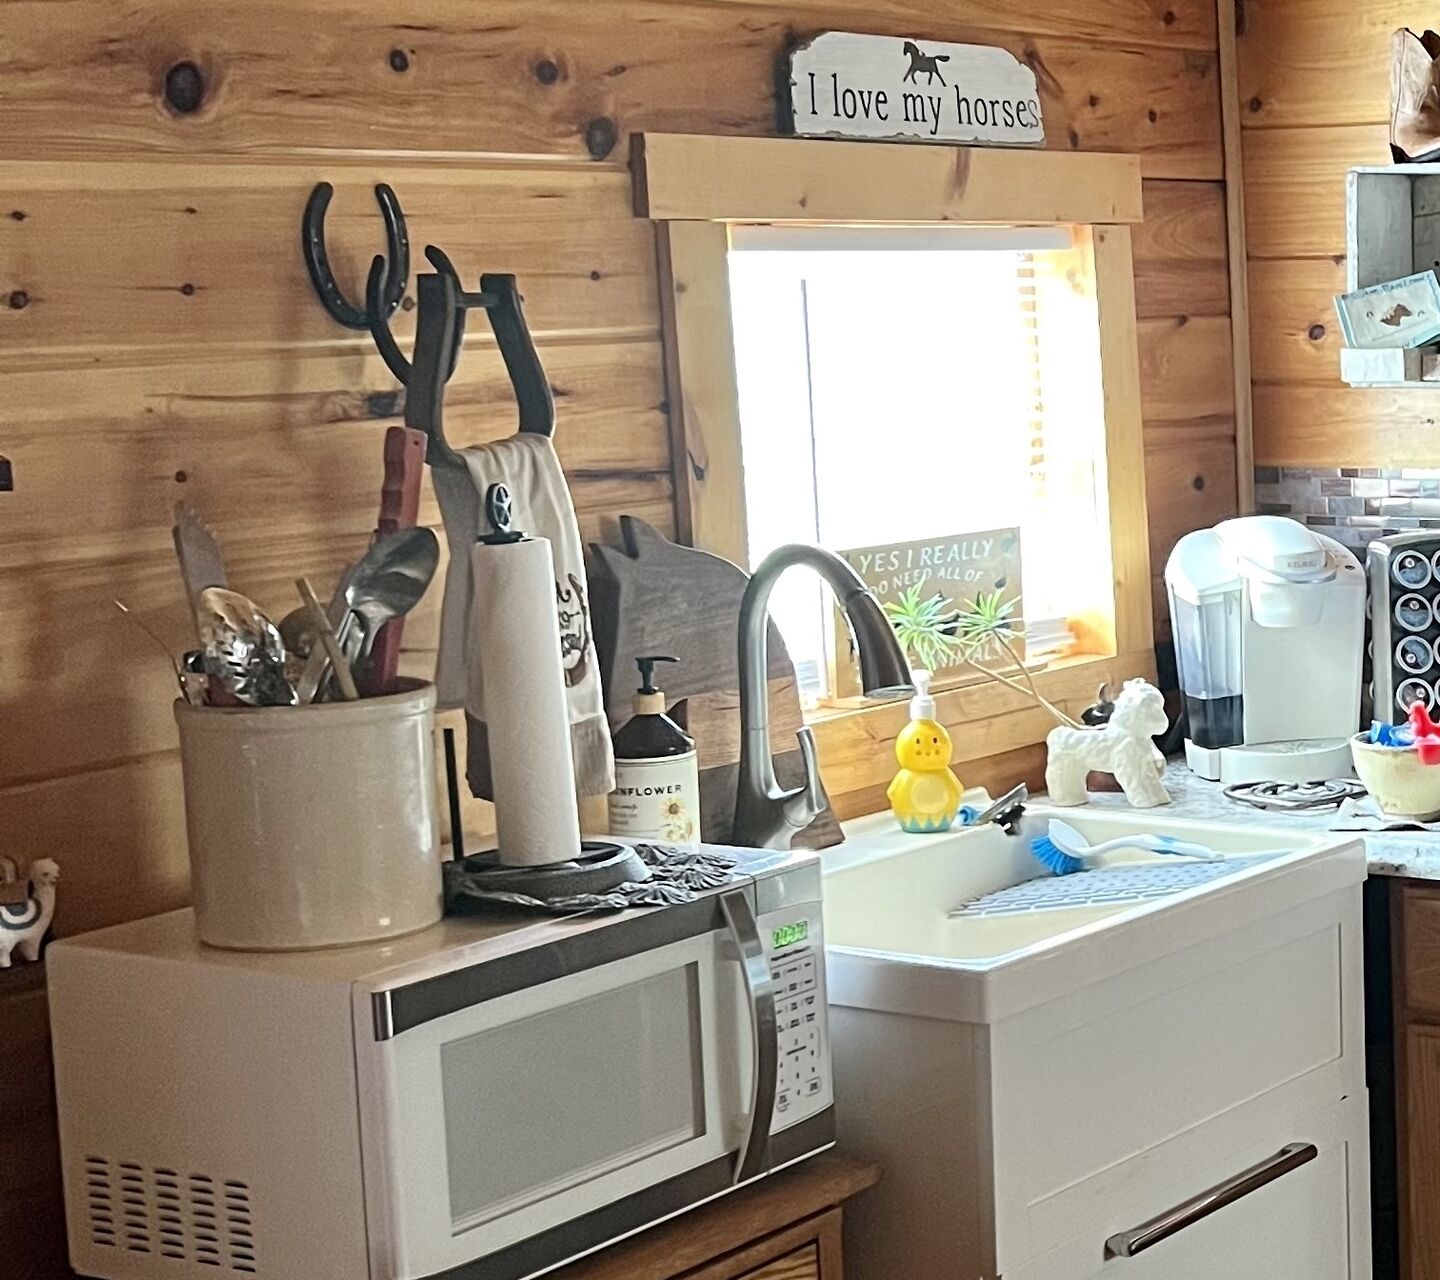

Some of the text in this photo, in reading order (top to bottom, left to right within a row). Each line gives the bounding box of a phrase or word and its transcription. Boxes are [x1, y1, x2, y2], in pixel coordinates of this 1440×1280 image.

[808, 72, 1040, 135] I love my horses
[859, 538, 993, 574] YES I REALLY
[869, 566, 984, 596] DO NEED ALL OF
